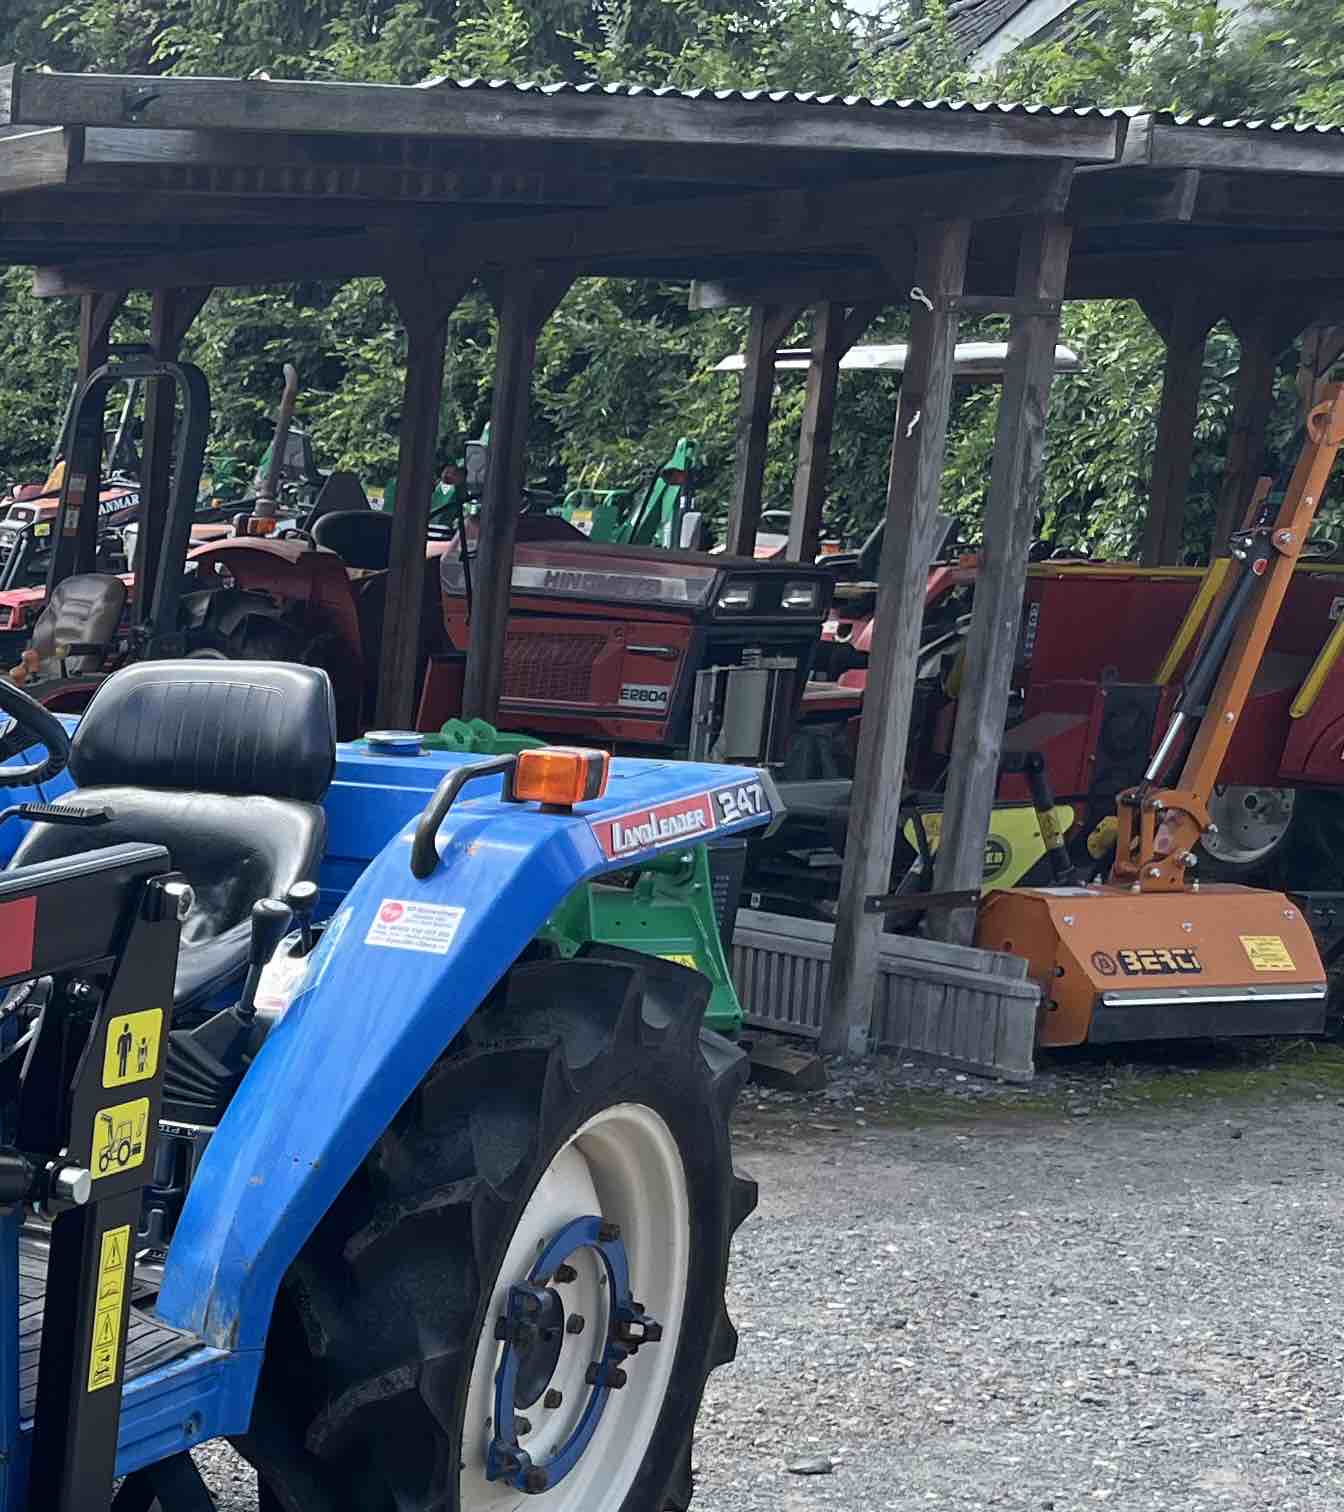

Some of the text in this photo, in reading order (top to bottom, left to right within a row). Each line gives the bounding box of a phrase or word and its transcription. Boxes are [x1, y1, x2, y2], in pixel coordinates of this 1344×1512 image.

[98, 494, 141, 516] ANMAR
[620, 687, 668, 703] E2804
[718, 783, 763, 825] 247
